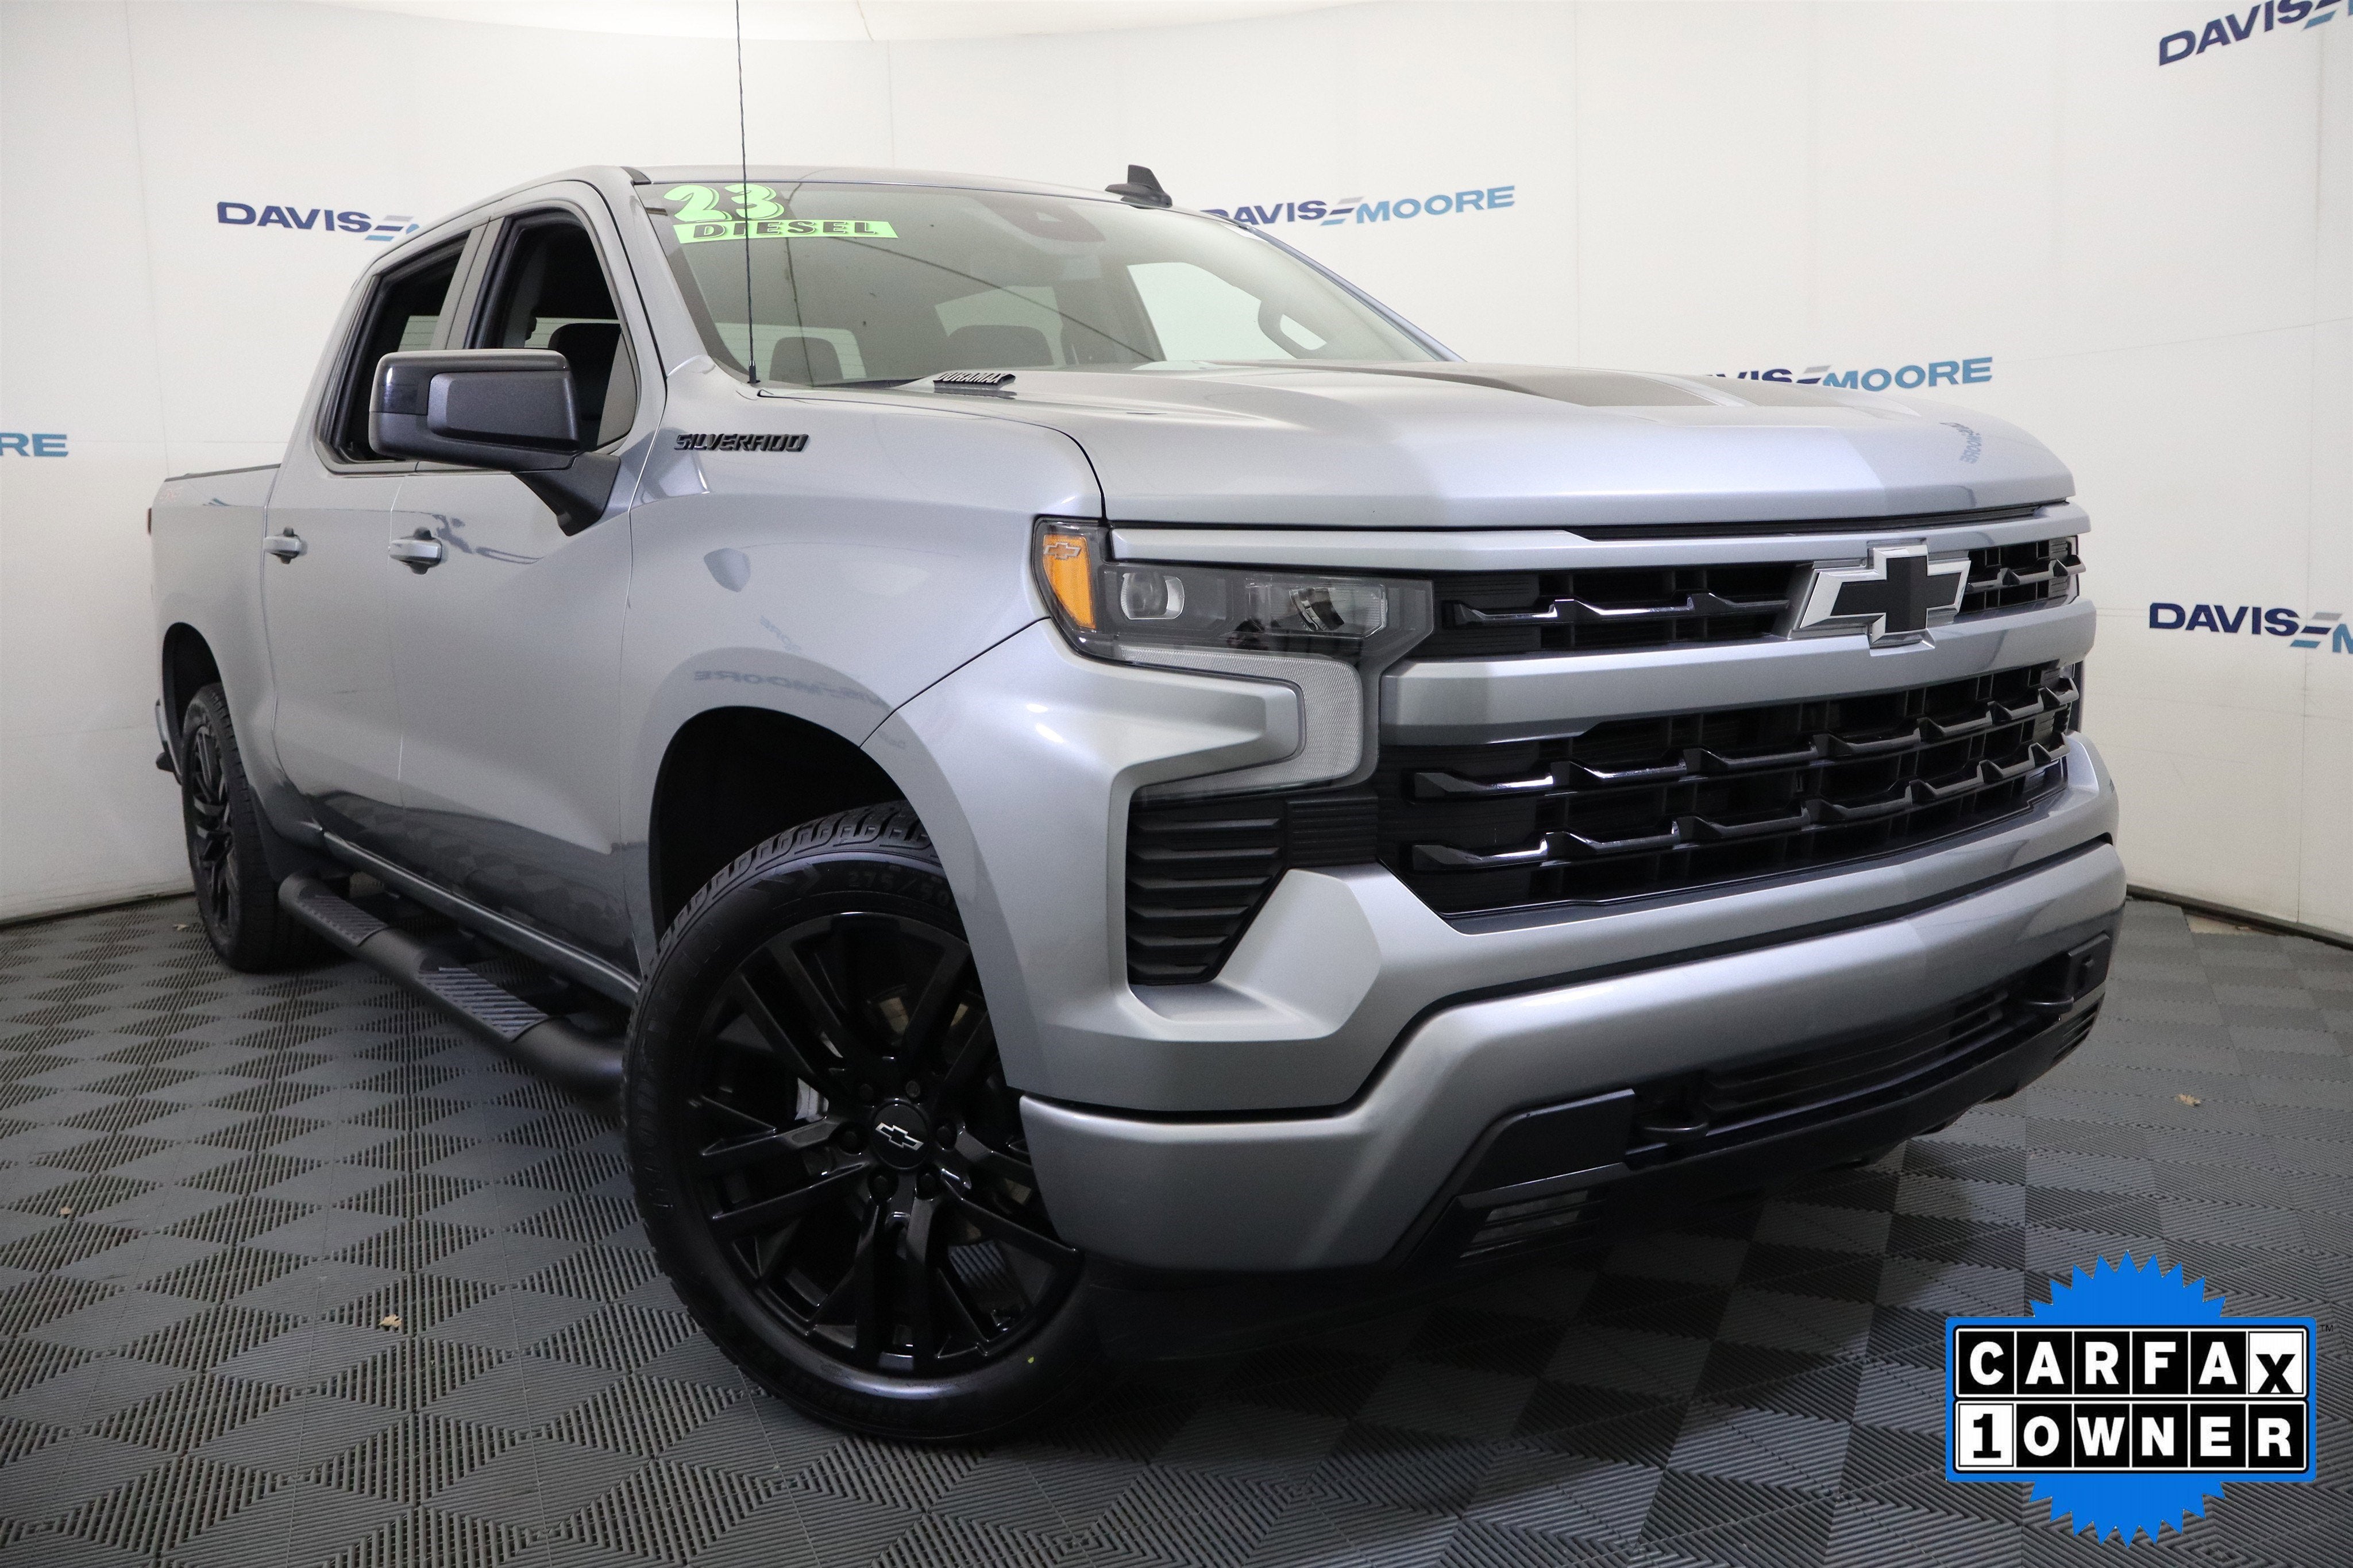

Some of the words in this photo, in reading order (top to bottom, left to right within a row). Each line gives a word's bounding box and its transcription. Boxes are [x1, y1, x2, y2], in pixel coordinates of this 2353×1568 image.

[2159, 0, 2313, 66] DAVIS
[217, 201, 372, 233] DAVIS
[664, 183, 785, 222] 23
[1356, 185, 1515, 224] MOORE
[693, 221, 878, 239] DIESEL
[1823, 357, 1993, 392] MOORE
[674, 433, 809, 452] SILVERADO
[2150, 602, 2300, 637] DAVIS
